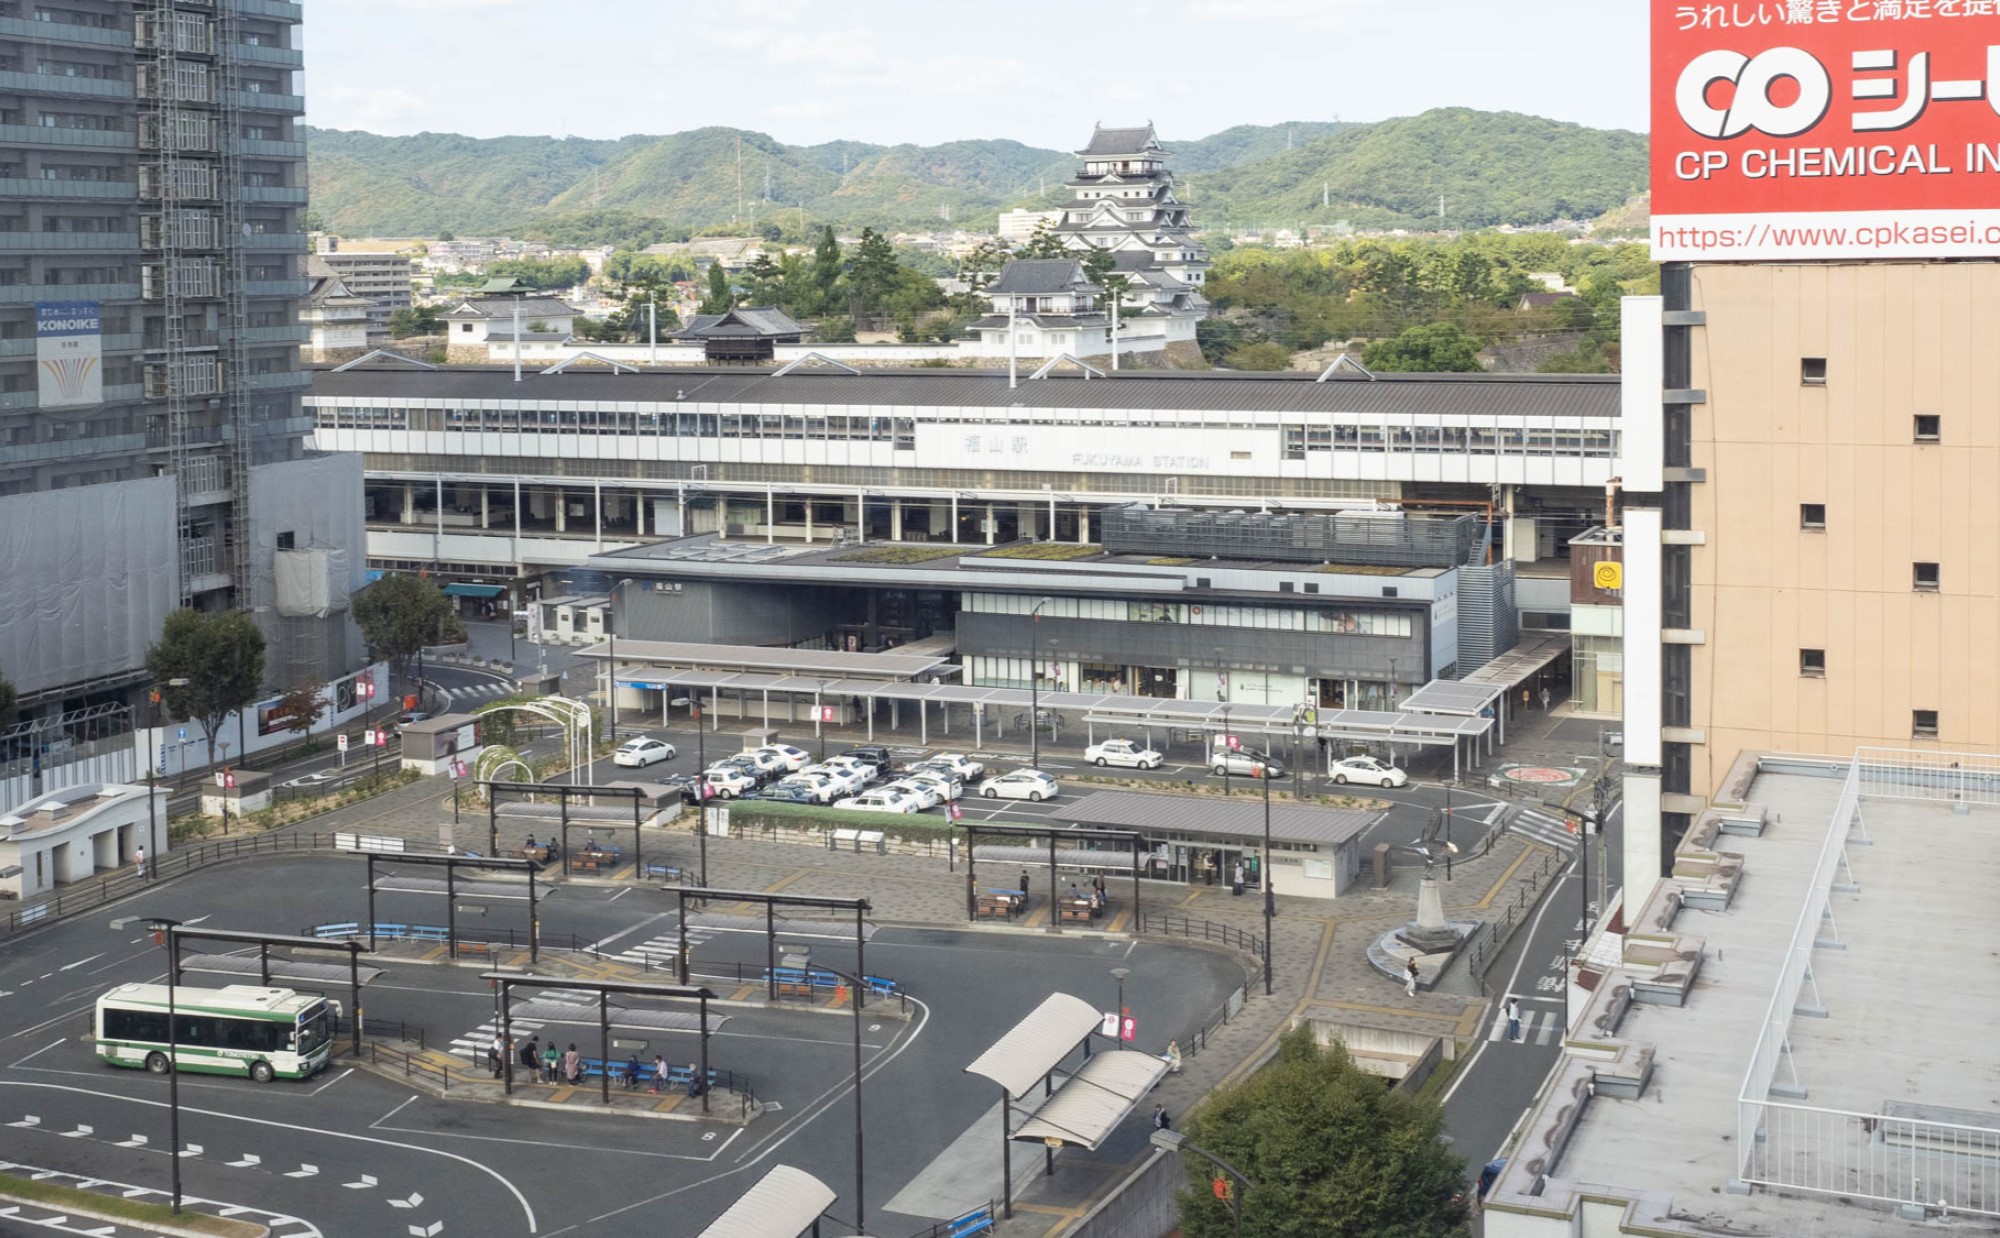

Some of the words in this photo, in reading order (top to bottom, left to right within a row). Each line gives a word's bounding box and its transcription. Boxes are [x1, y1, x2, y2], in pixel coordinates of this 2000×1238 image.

[1675, 0, 2000, 30] うれしい驚きと満足を提
[1852, 46, 2000, 132] シー
[1675, 150, 1729, 180] CP
[1741, 144, 1952, 179] CHEMICAL
[1659, 220, 2000, 250] https://www.cpkasei.c
[38, 318, 98, 331] KONOIKE
[1072, 452, 1143, 468] FUKUYAMA
[1152, 454, 1209, 470] STATION
